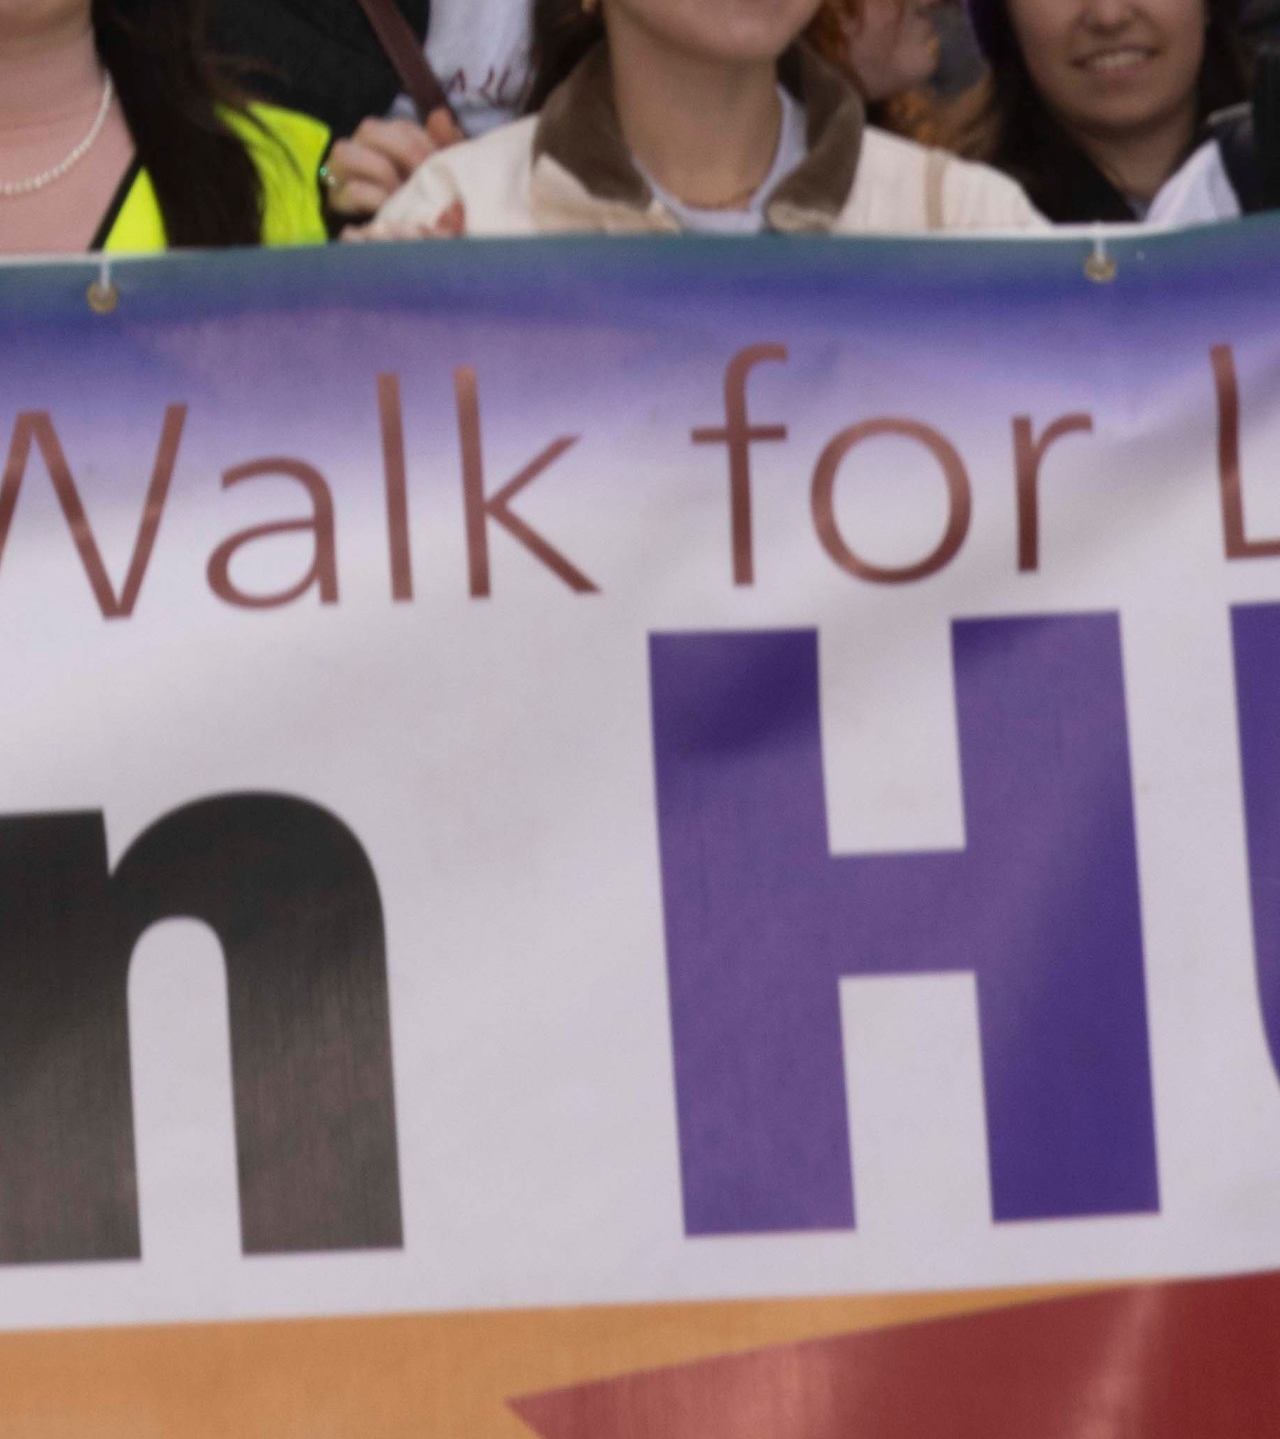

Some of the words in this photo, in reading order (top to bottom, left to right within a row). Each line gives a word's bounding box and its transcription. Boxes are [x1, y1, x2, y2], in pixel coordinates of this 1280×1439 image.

[689, 340, 1094, 586] for
[1209, 343, 1280, 560] L
[647, 598, 1280, 1239] H
